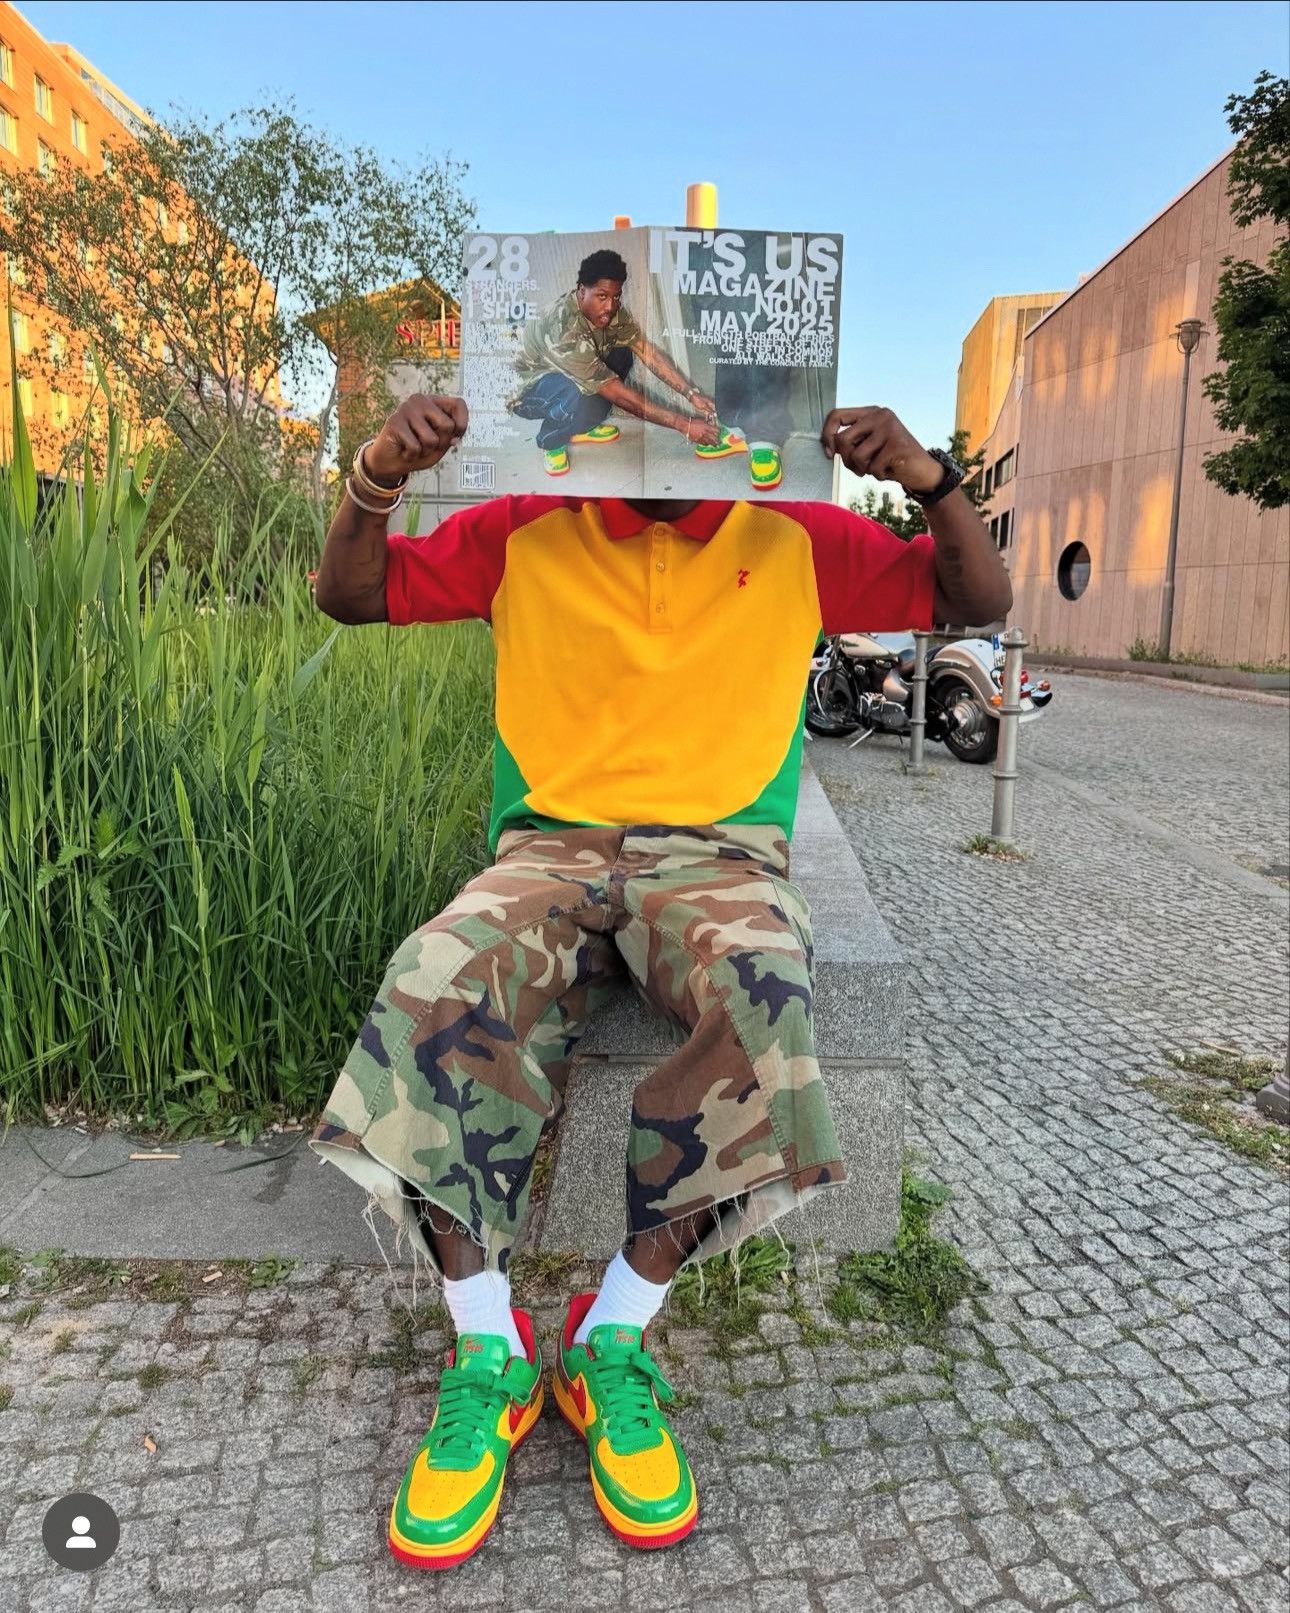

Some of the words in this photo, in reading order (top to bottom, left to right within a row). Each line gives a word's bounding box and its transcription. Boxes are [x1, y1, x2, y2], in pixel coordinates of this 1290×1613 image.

[467, 235, 530, 281] 28
[650, 229, 747, 278] IT'S
[766, 236, 839, 280] US
[673, 270, 835, 301] MAGAZINE
[700, 310, 758, 333] MAY
[766, 313, 834, 336] 2025
[662, 328, 670, 337] A
[746, 330, 795, 341] PORTRAIT
[799, 333, 835, 343] SERIES
[692, 335, 722, 345] FROM
[724, 337, 744, 347] THE
[746, 338, 792, 349] STREETS
[795, 339, 808, 349] OF
[810, 340, 832, 350] NYC
[721, 343, 743, 353] ONE
[745, 344, 772, 353] STEP
[775, 345, 786, 354] IN
[788, 346, 833, 357] COMMON
[756, 351, 791, 362] WALKS
[794, 352, 807, 362] OF
[709, 357, 742, 365] CURATED
[743, 357, 754, 365] BY
[769, 359, 807, 368] CONCRETE
[809, 360, 834, 369] FAMILY
